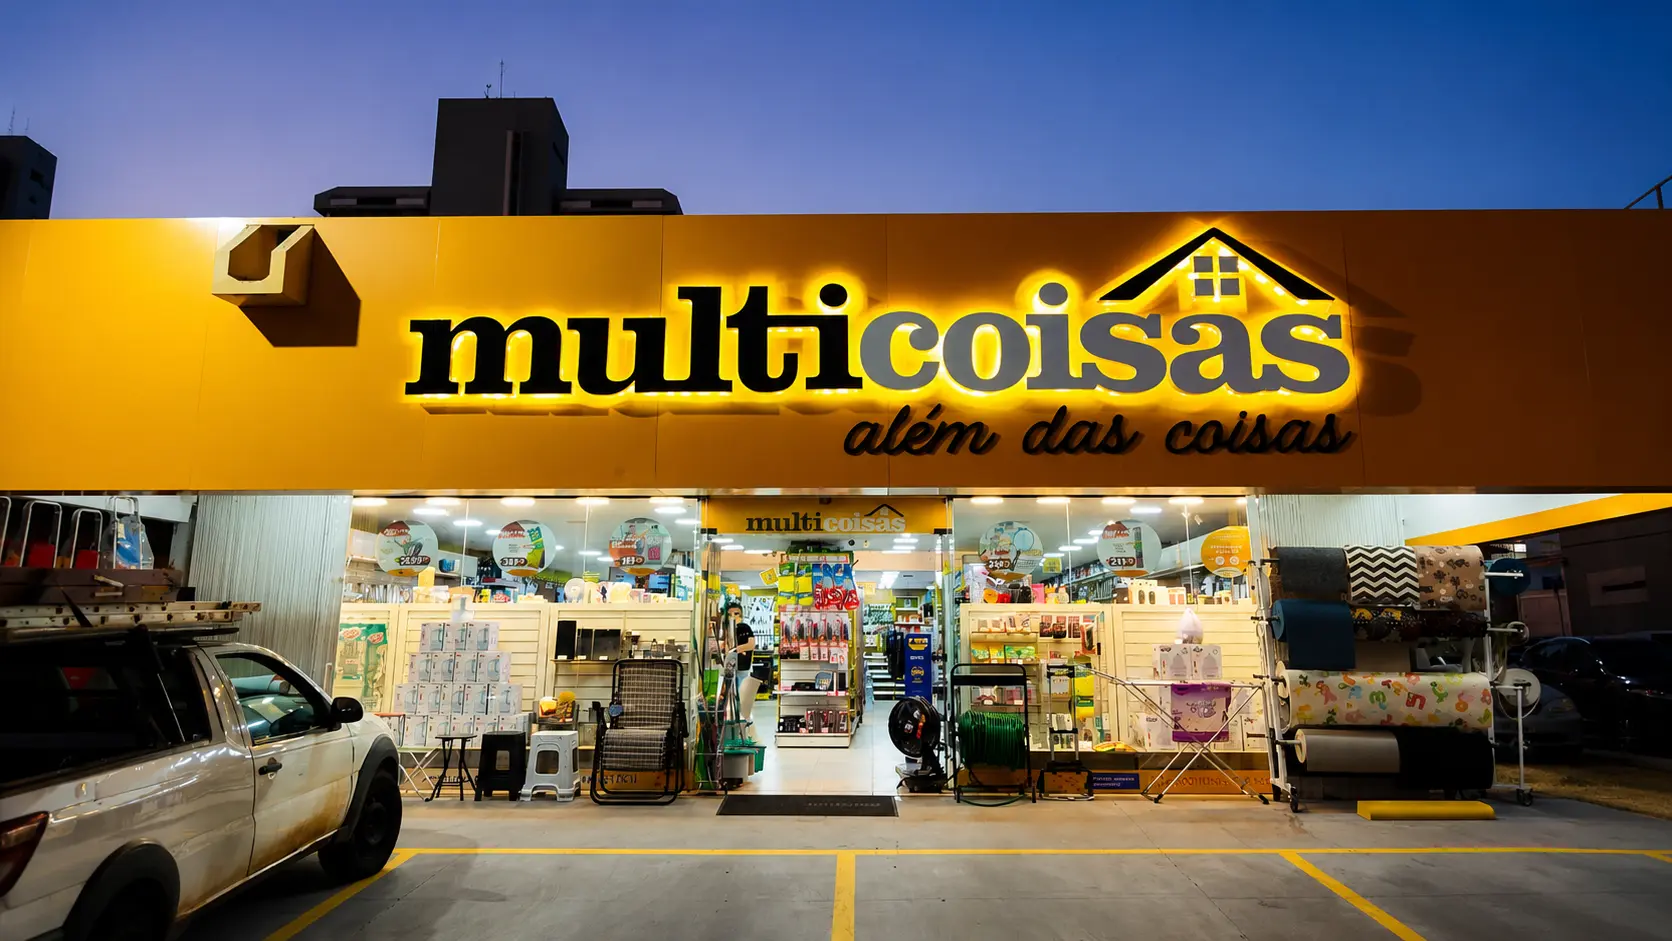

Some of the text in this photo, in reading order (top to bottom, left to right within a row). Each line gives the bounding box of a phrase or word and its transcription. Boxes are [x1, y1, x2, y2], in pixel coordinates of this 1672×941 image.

[405, 282, 1350, 394] multicoisas
[844, 404, 1353, 456] além das coisas
[745, 511, 906, 533] multicoisas
